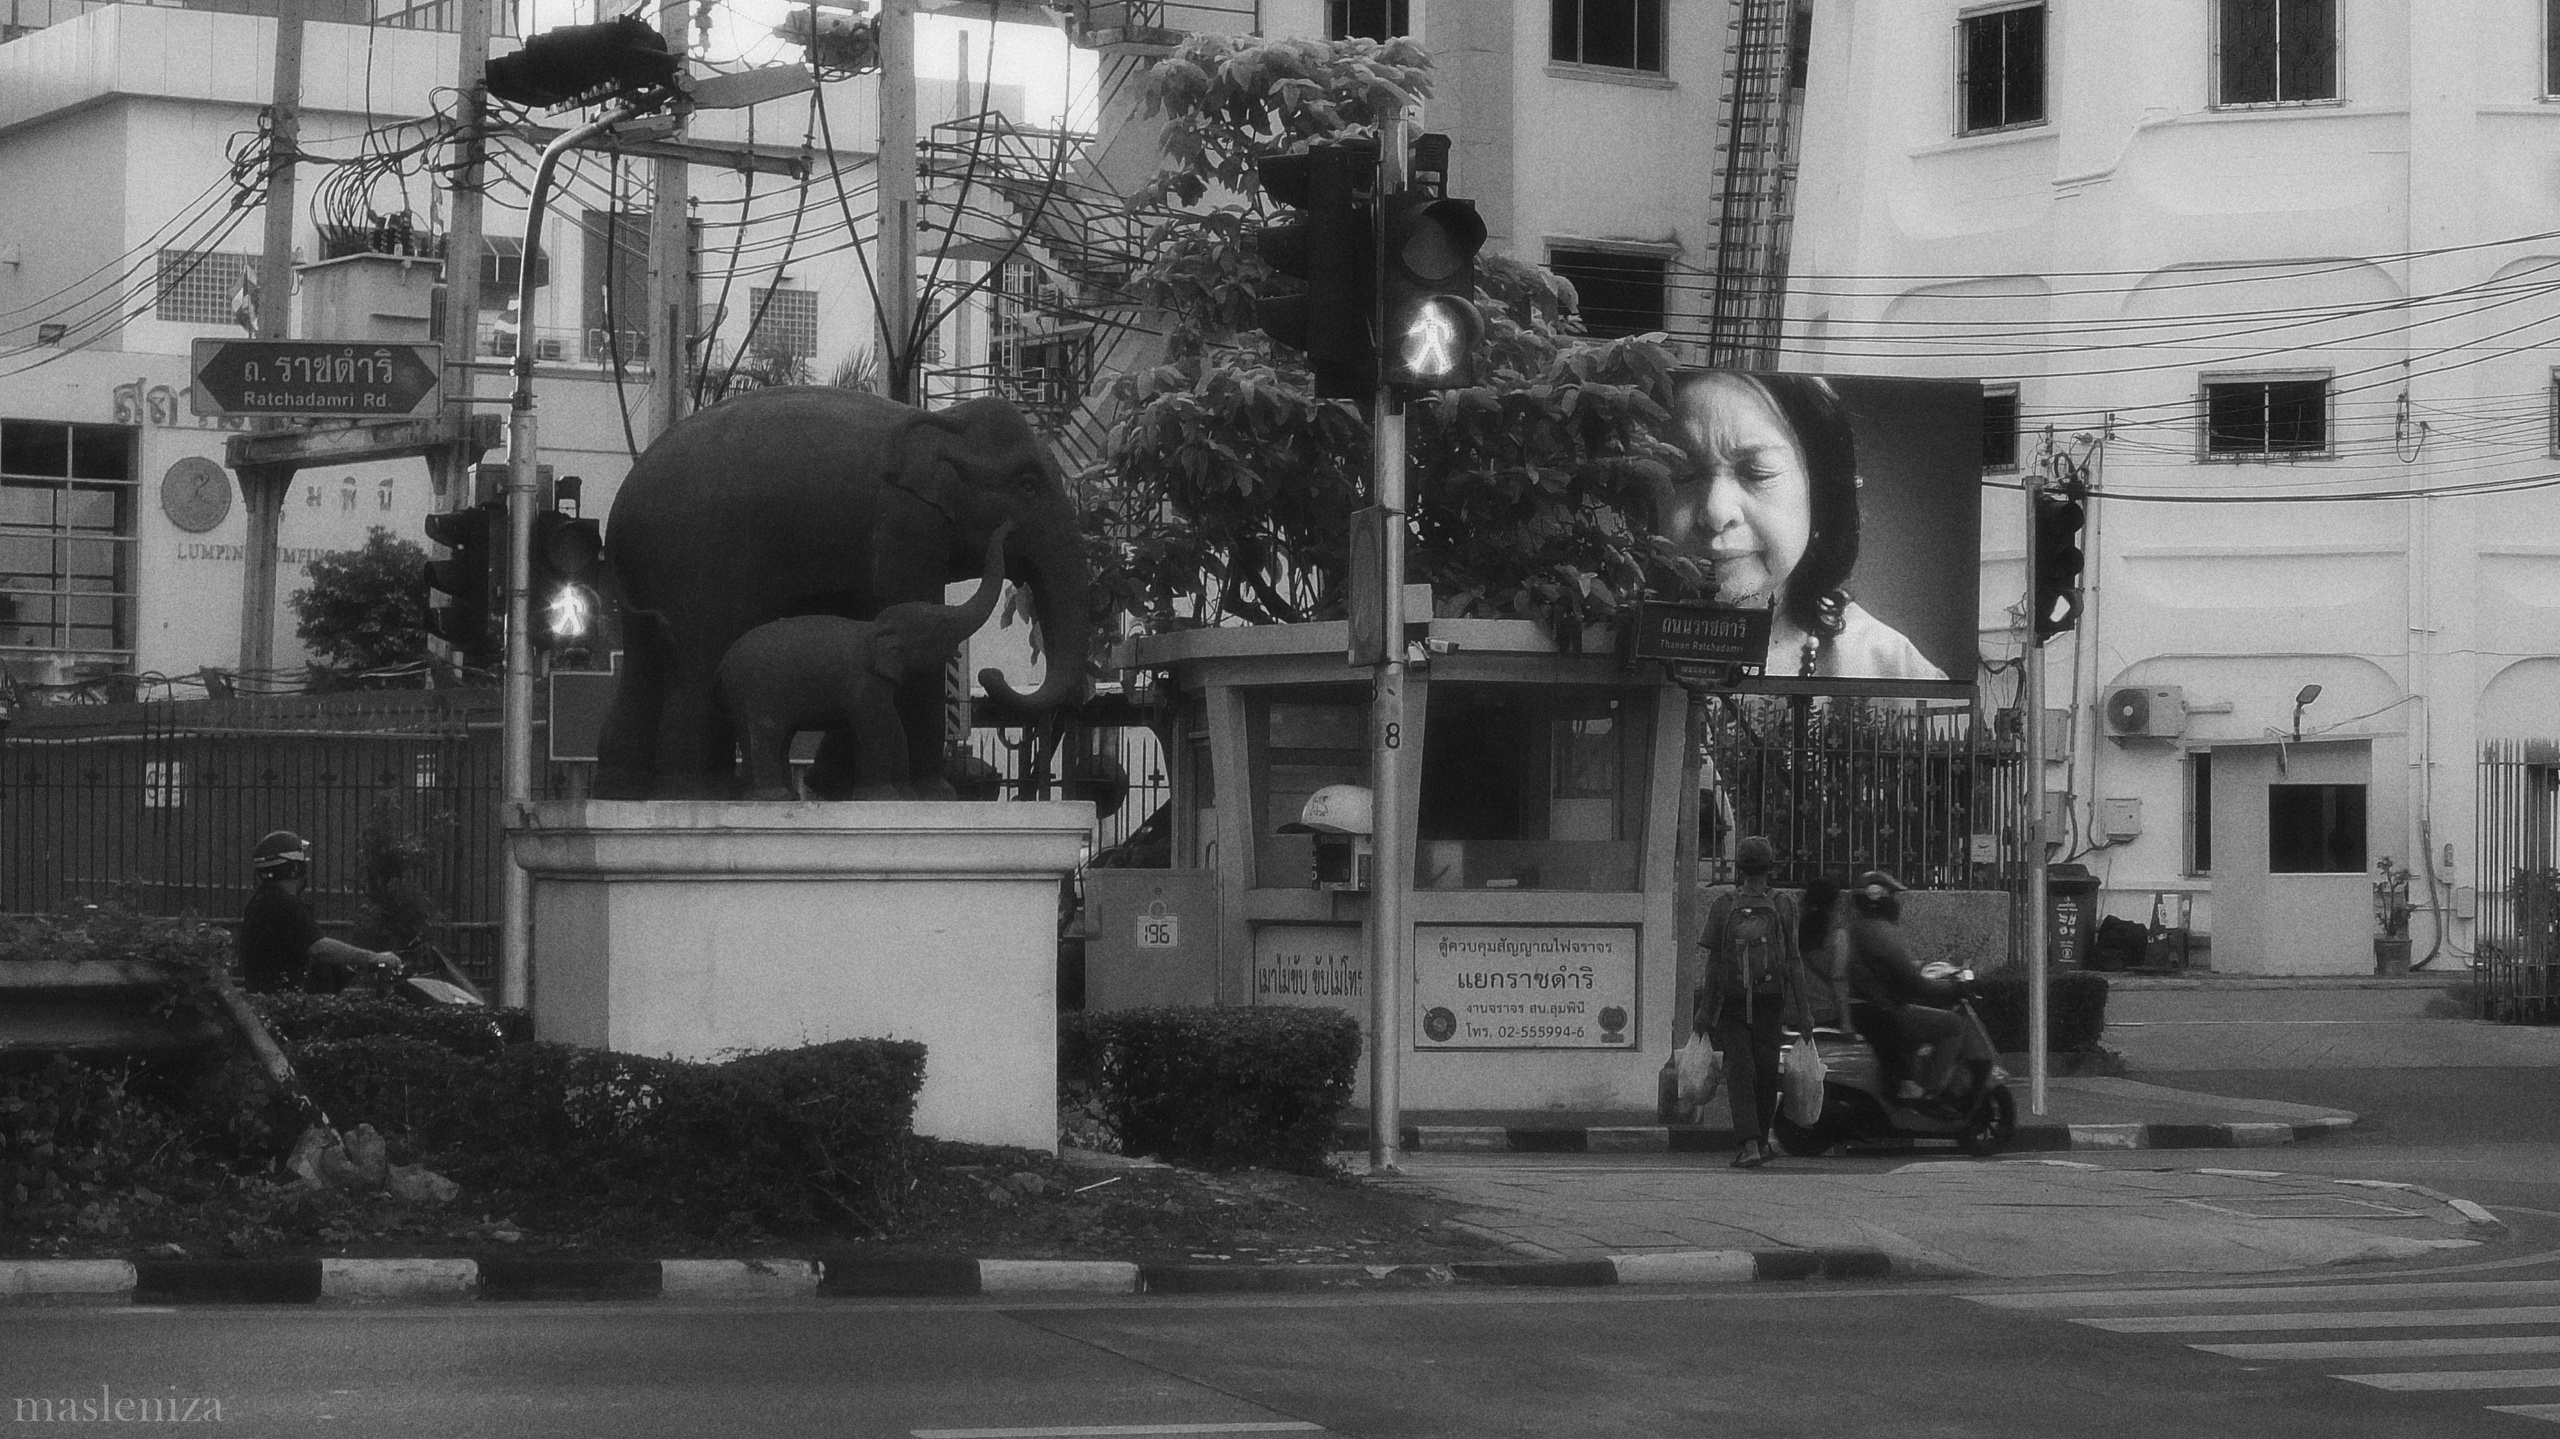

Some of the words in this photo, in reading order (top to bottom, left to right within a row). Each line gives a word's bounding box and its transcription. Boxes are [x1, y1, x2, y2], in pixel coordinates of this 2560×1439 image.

[244, 360, 267, 383] ถ.
[275, 347, 393, 384] ราชดำริ
[243, 391, 355, 407] Ratchadamri
[363, 392, 392, 408] Rd.
[177, 543, 244, 561] LUMPIN
[1662, 616, 1747, 638] ถนนราชดำริ
[1385, 722, 1400, 749] 8
[1145, 924, 1170, 944] 196
[1438, 936, 1613, 958] ตู้ควบคุมสัญญาณไฟจราจร
[1457, 965, 1595, 989] แยกราชดำริ
[1465, 1022, 1493, 1039] โทร.
[1498, 1025, 1585, 1038] 02-555994-6
